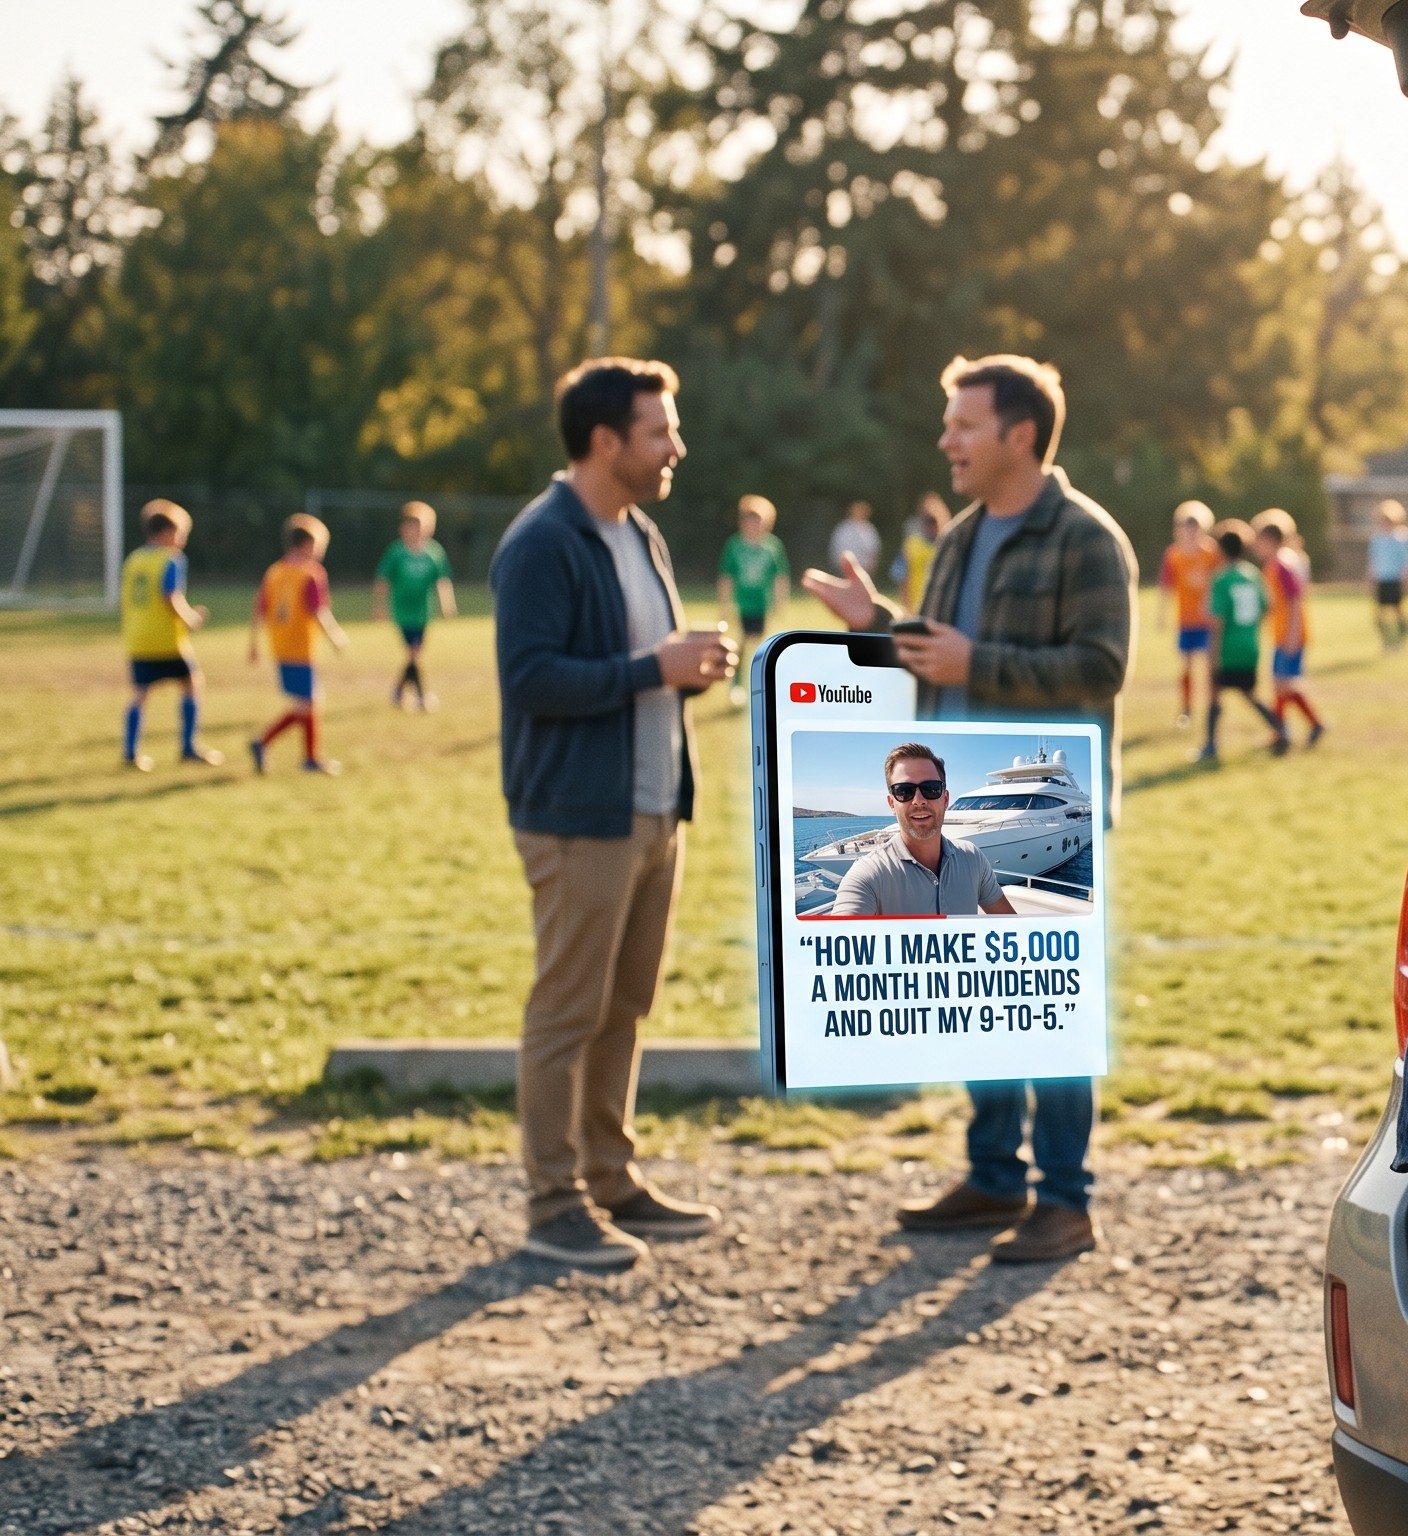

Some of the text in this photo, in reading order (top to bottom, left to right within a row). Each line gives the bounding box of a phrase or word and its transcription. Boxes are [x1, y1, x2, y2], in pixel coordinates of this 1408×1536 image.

[818, 684, 872, 704] YouTube
[800, 930, 1080, 967] “HOW I MAKE $5,000
[811, 968, 1081, 1003] A MONTH IN DIVIDENDS
[824, 1002, 1076, 1038] AND QUIT MY 9-TO-5.”
